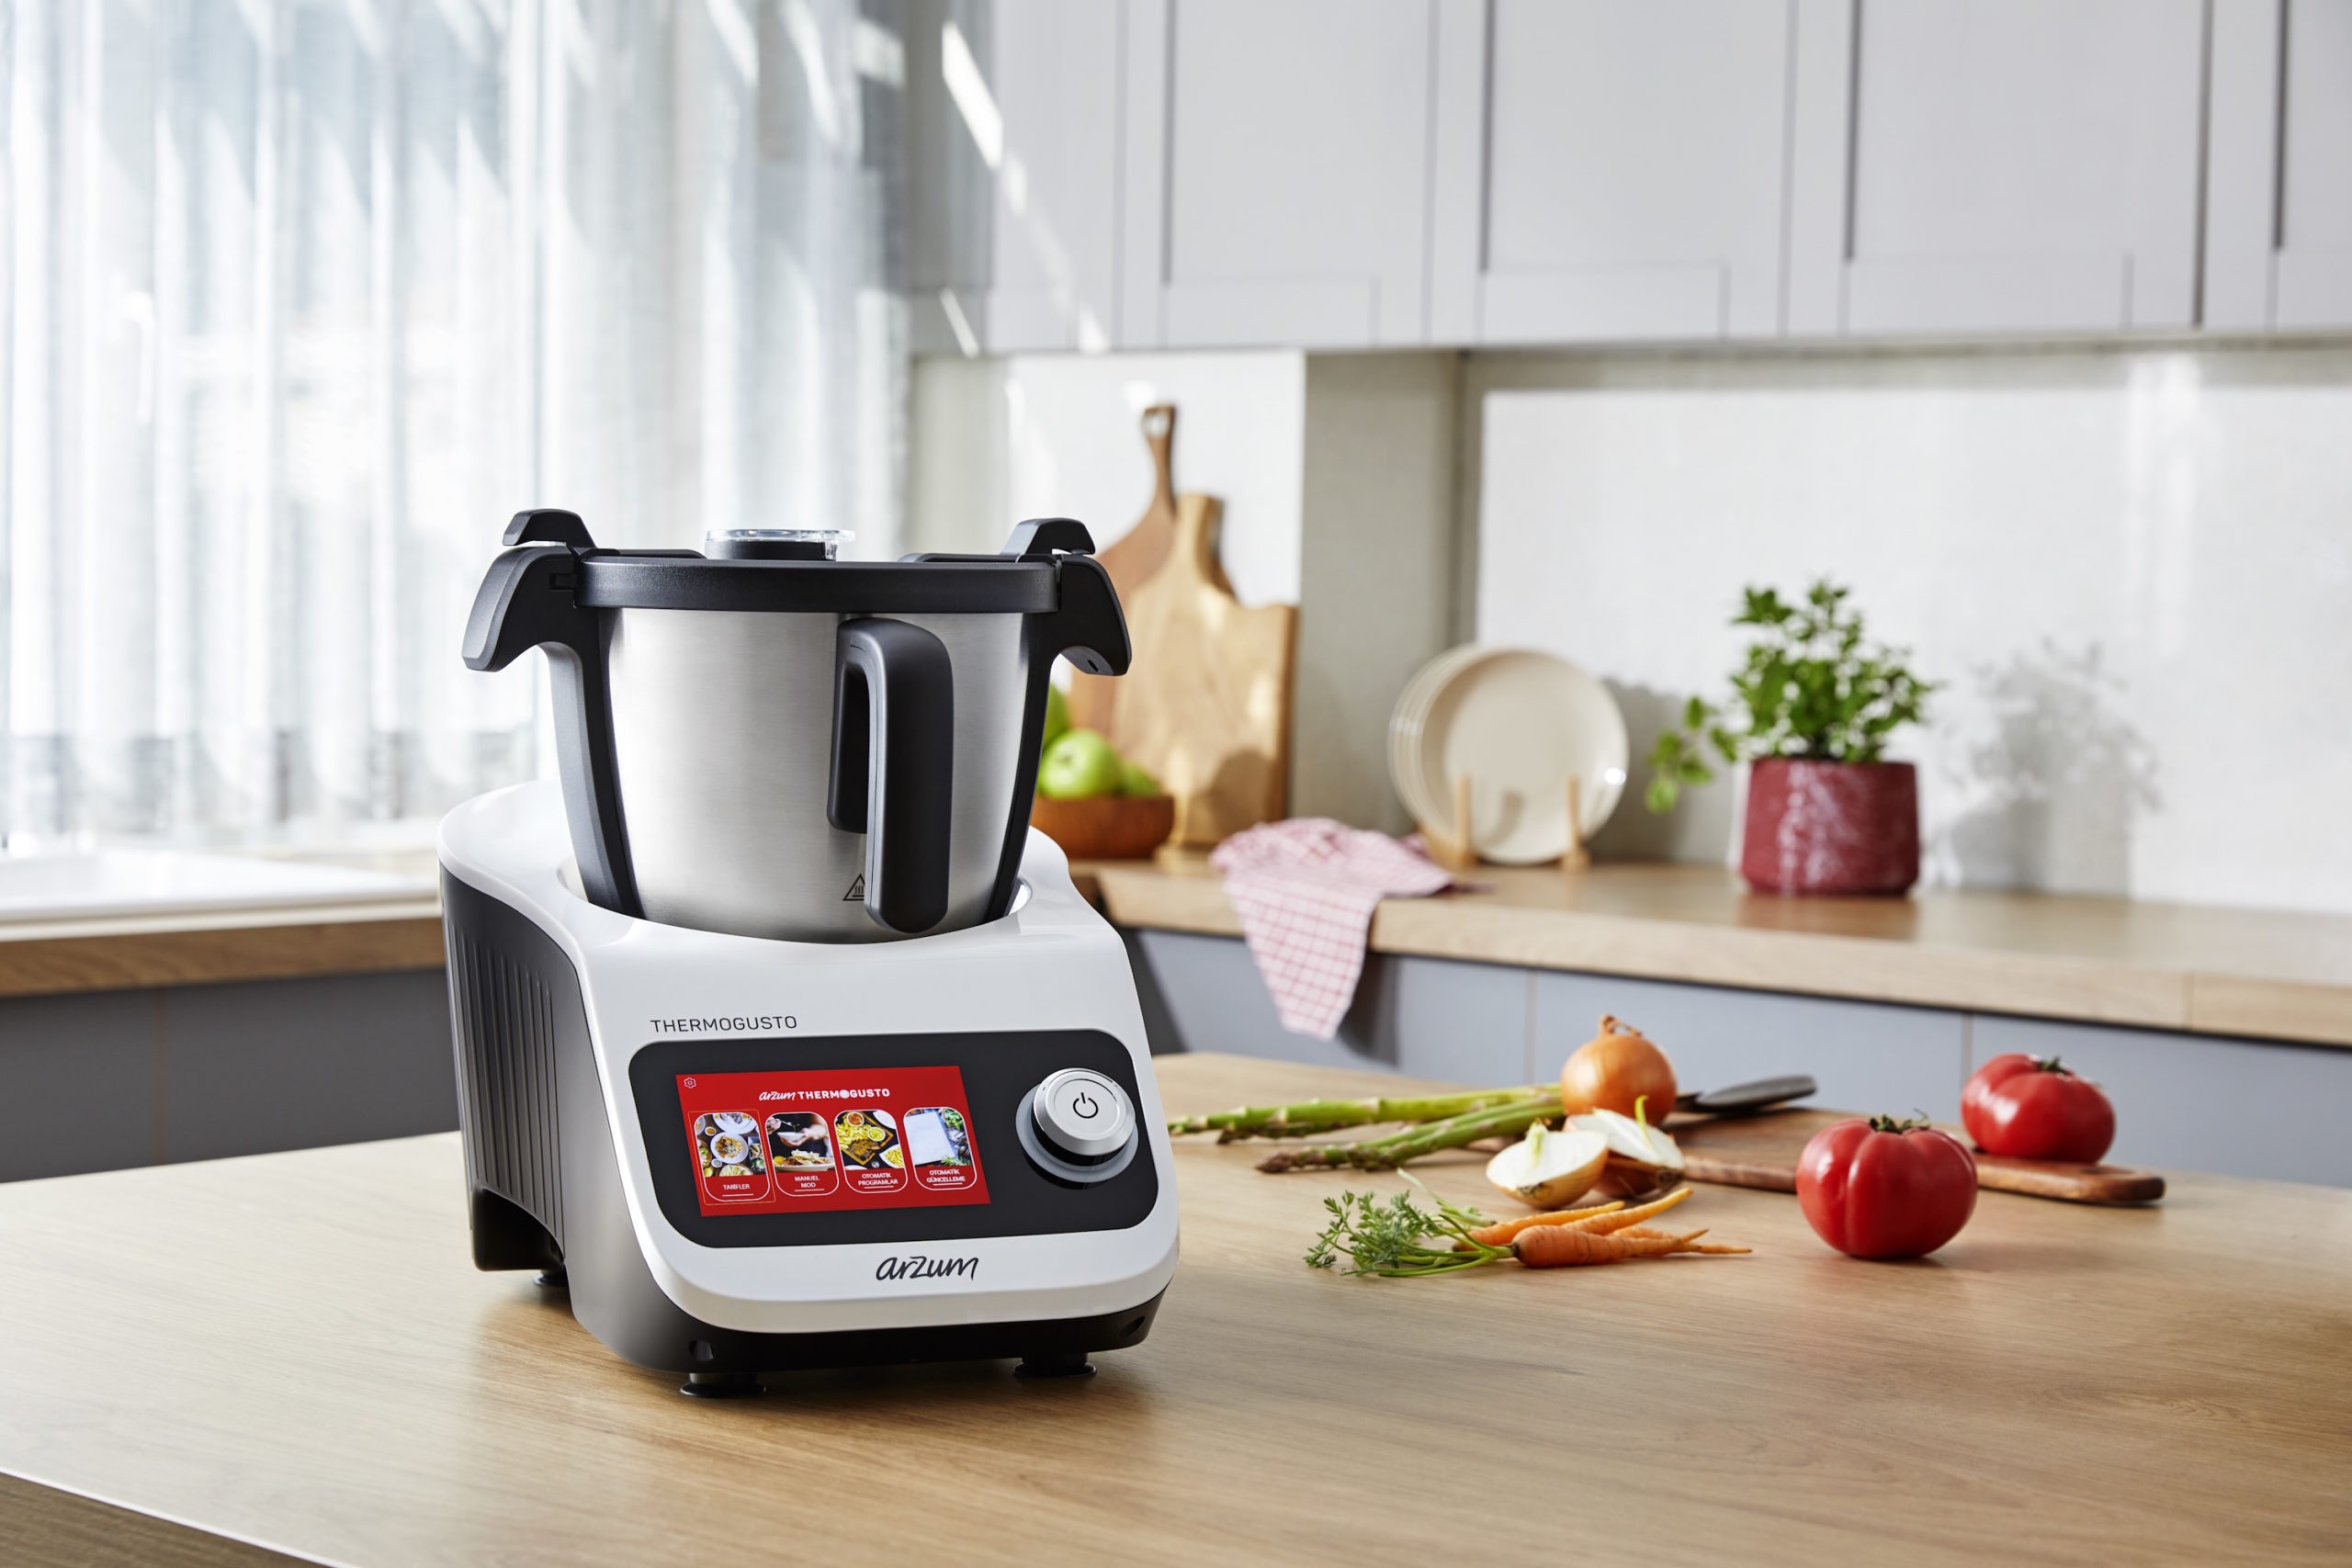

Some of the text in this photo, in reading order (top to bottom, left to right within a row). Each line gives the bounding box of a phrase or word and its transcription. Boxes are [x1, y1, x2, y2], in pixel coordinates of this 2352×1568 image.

[650, 1015, 797, 1033] THERMOGUSTO
[758, 1090, 796, 1101] arzum
[876, 1256, 978, 1280] arzum
